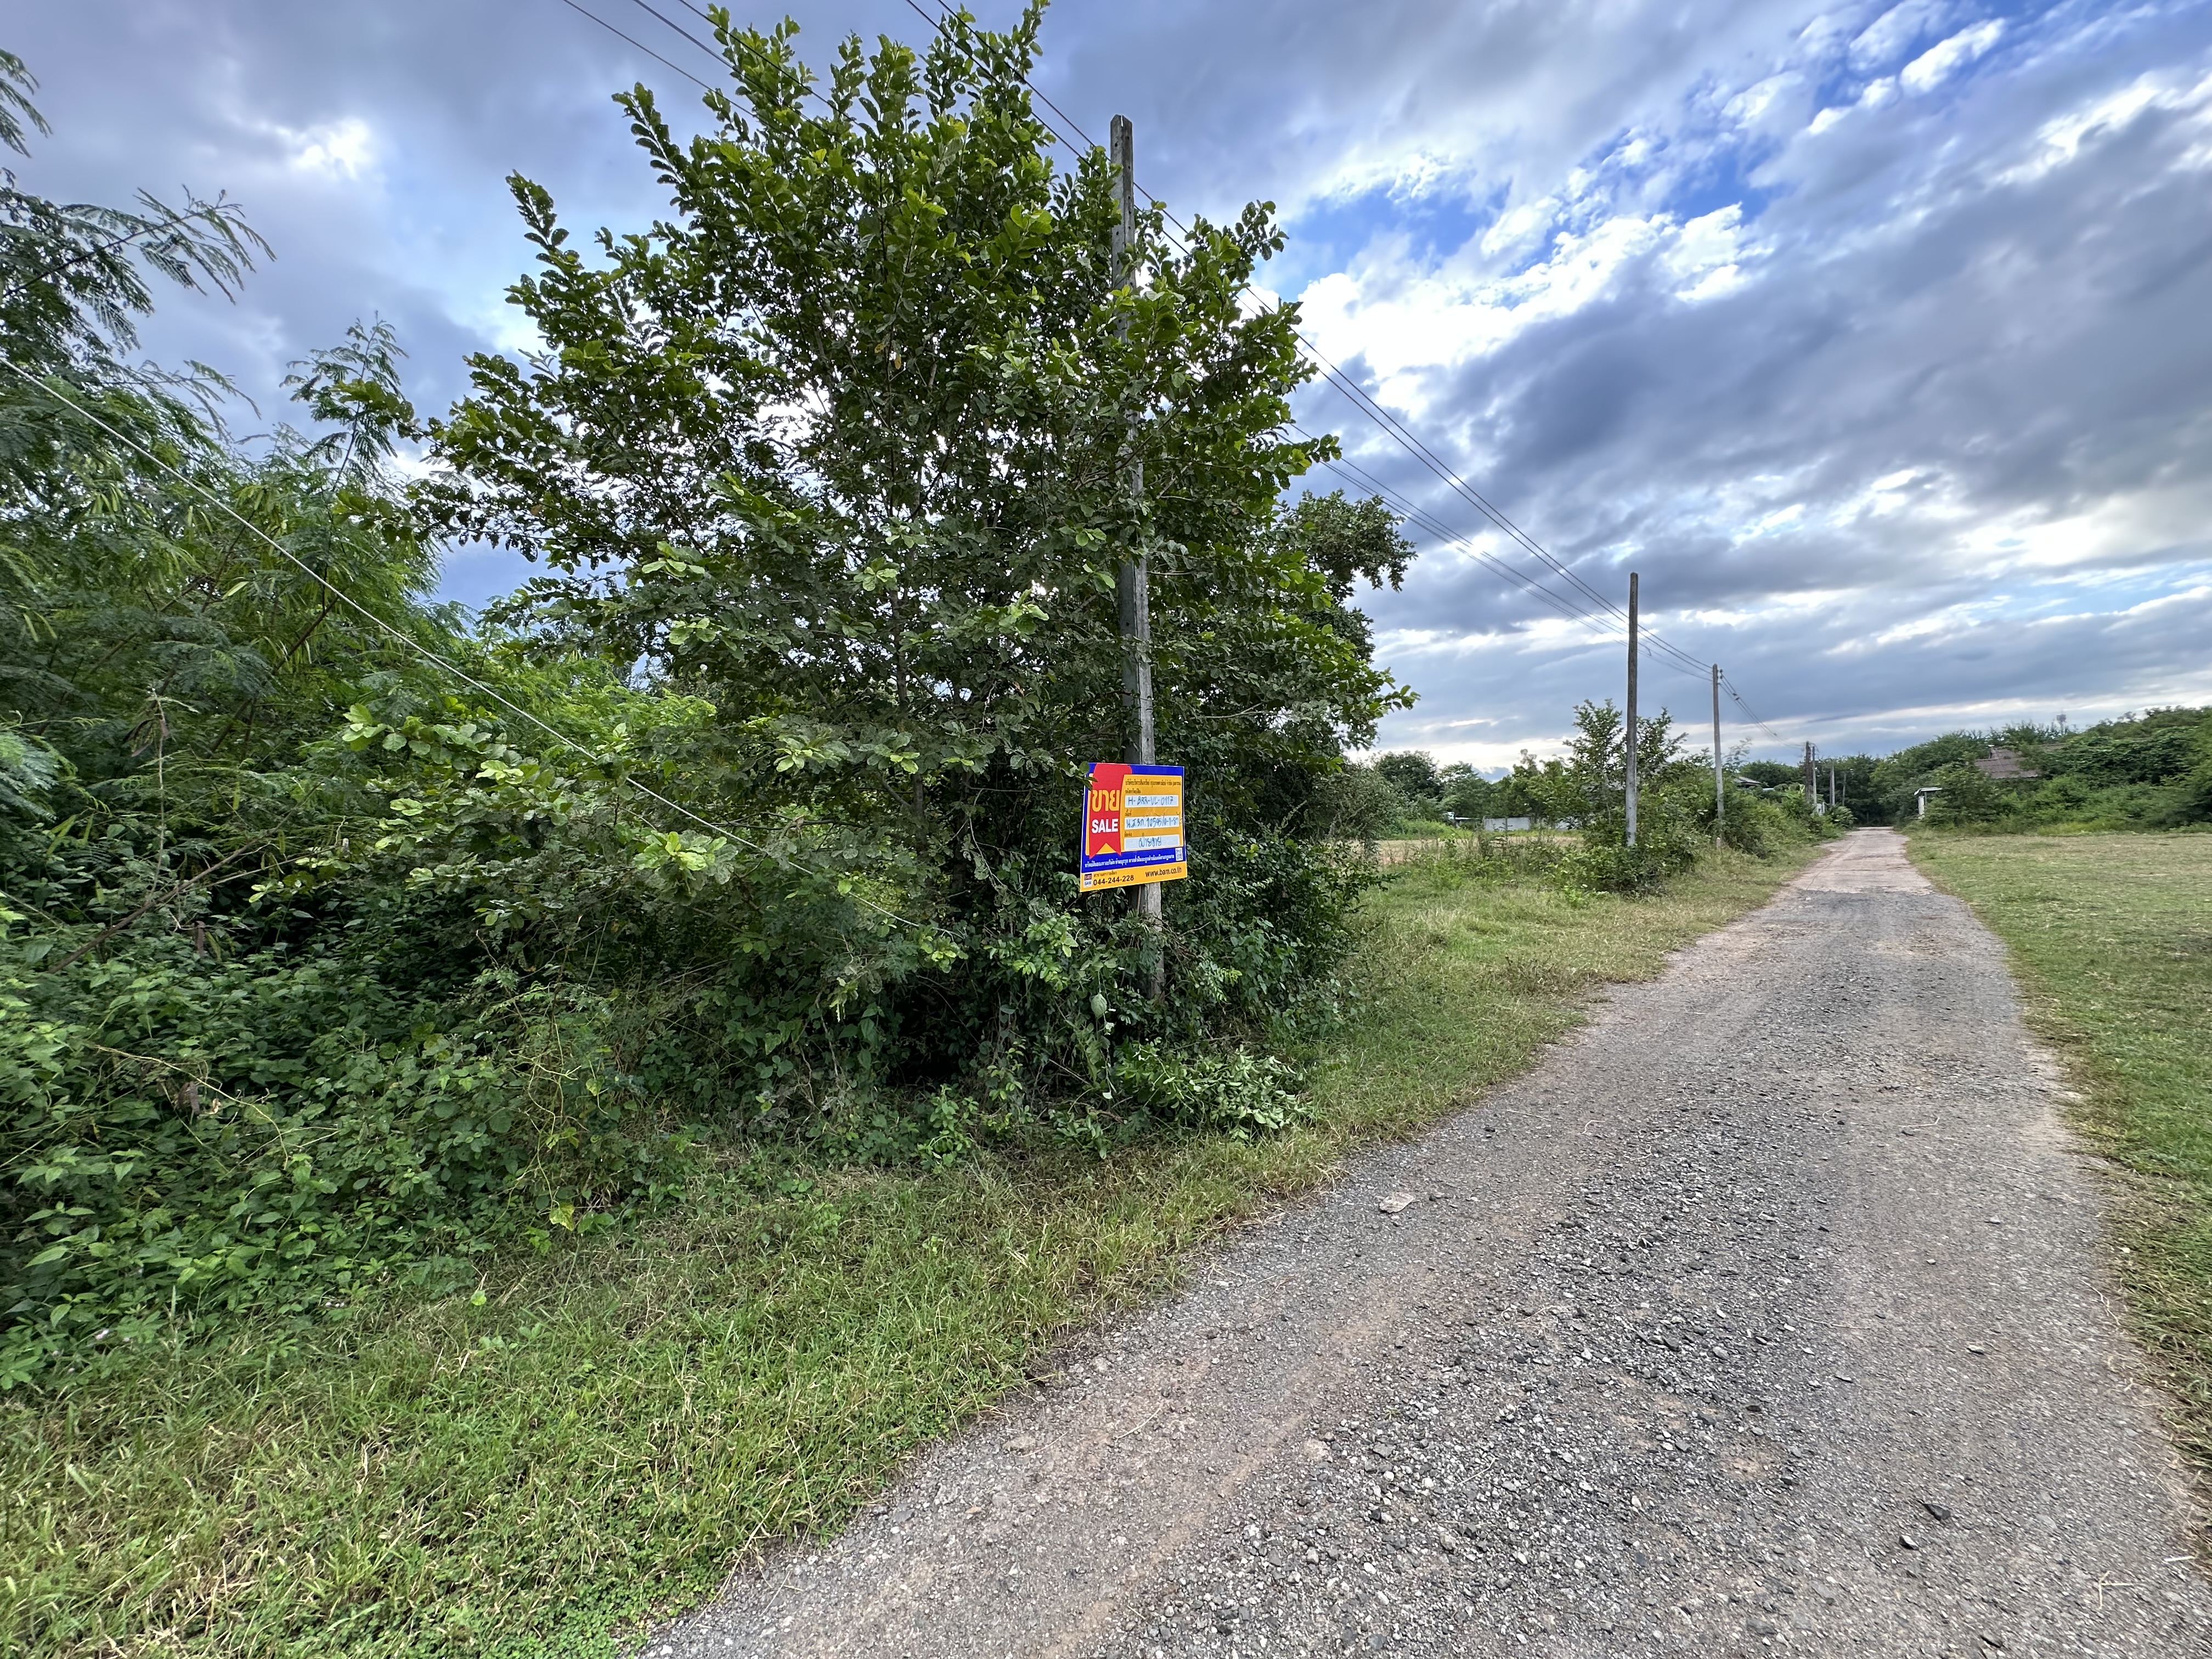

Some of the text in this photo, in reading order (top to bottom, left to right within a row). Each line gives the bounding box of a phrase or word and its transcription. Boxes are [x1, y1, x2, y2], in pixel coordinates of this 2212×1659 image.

[1092, 789, 1120, 811] ขาย
[1092, 819, 1119, 833] SALE
[1145, 866, 1182, 877] www.bam.co.th
[1093, 874, 1135, 886] 044-244-228
